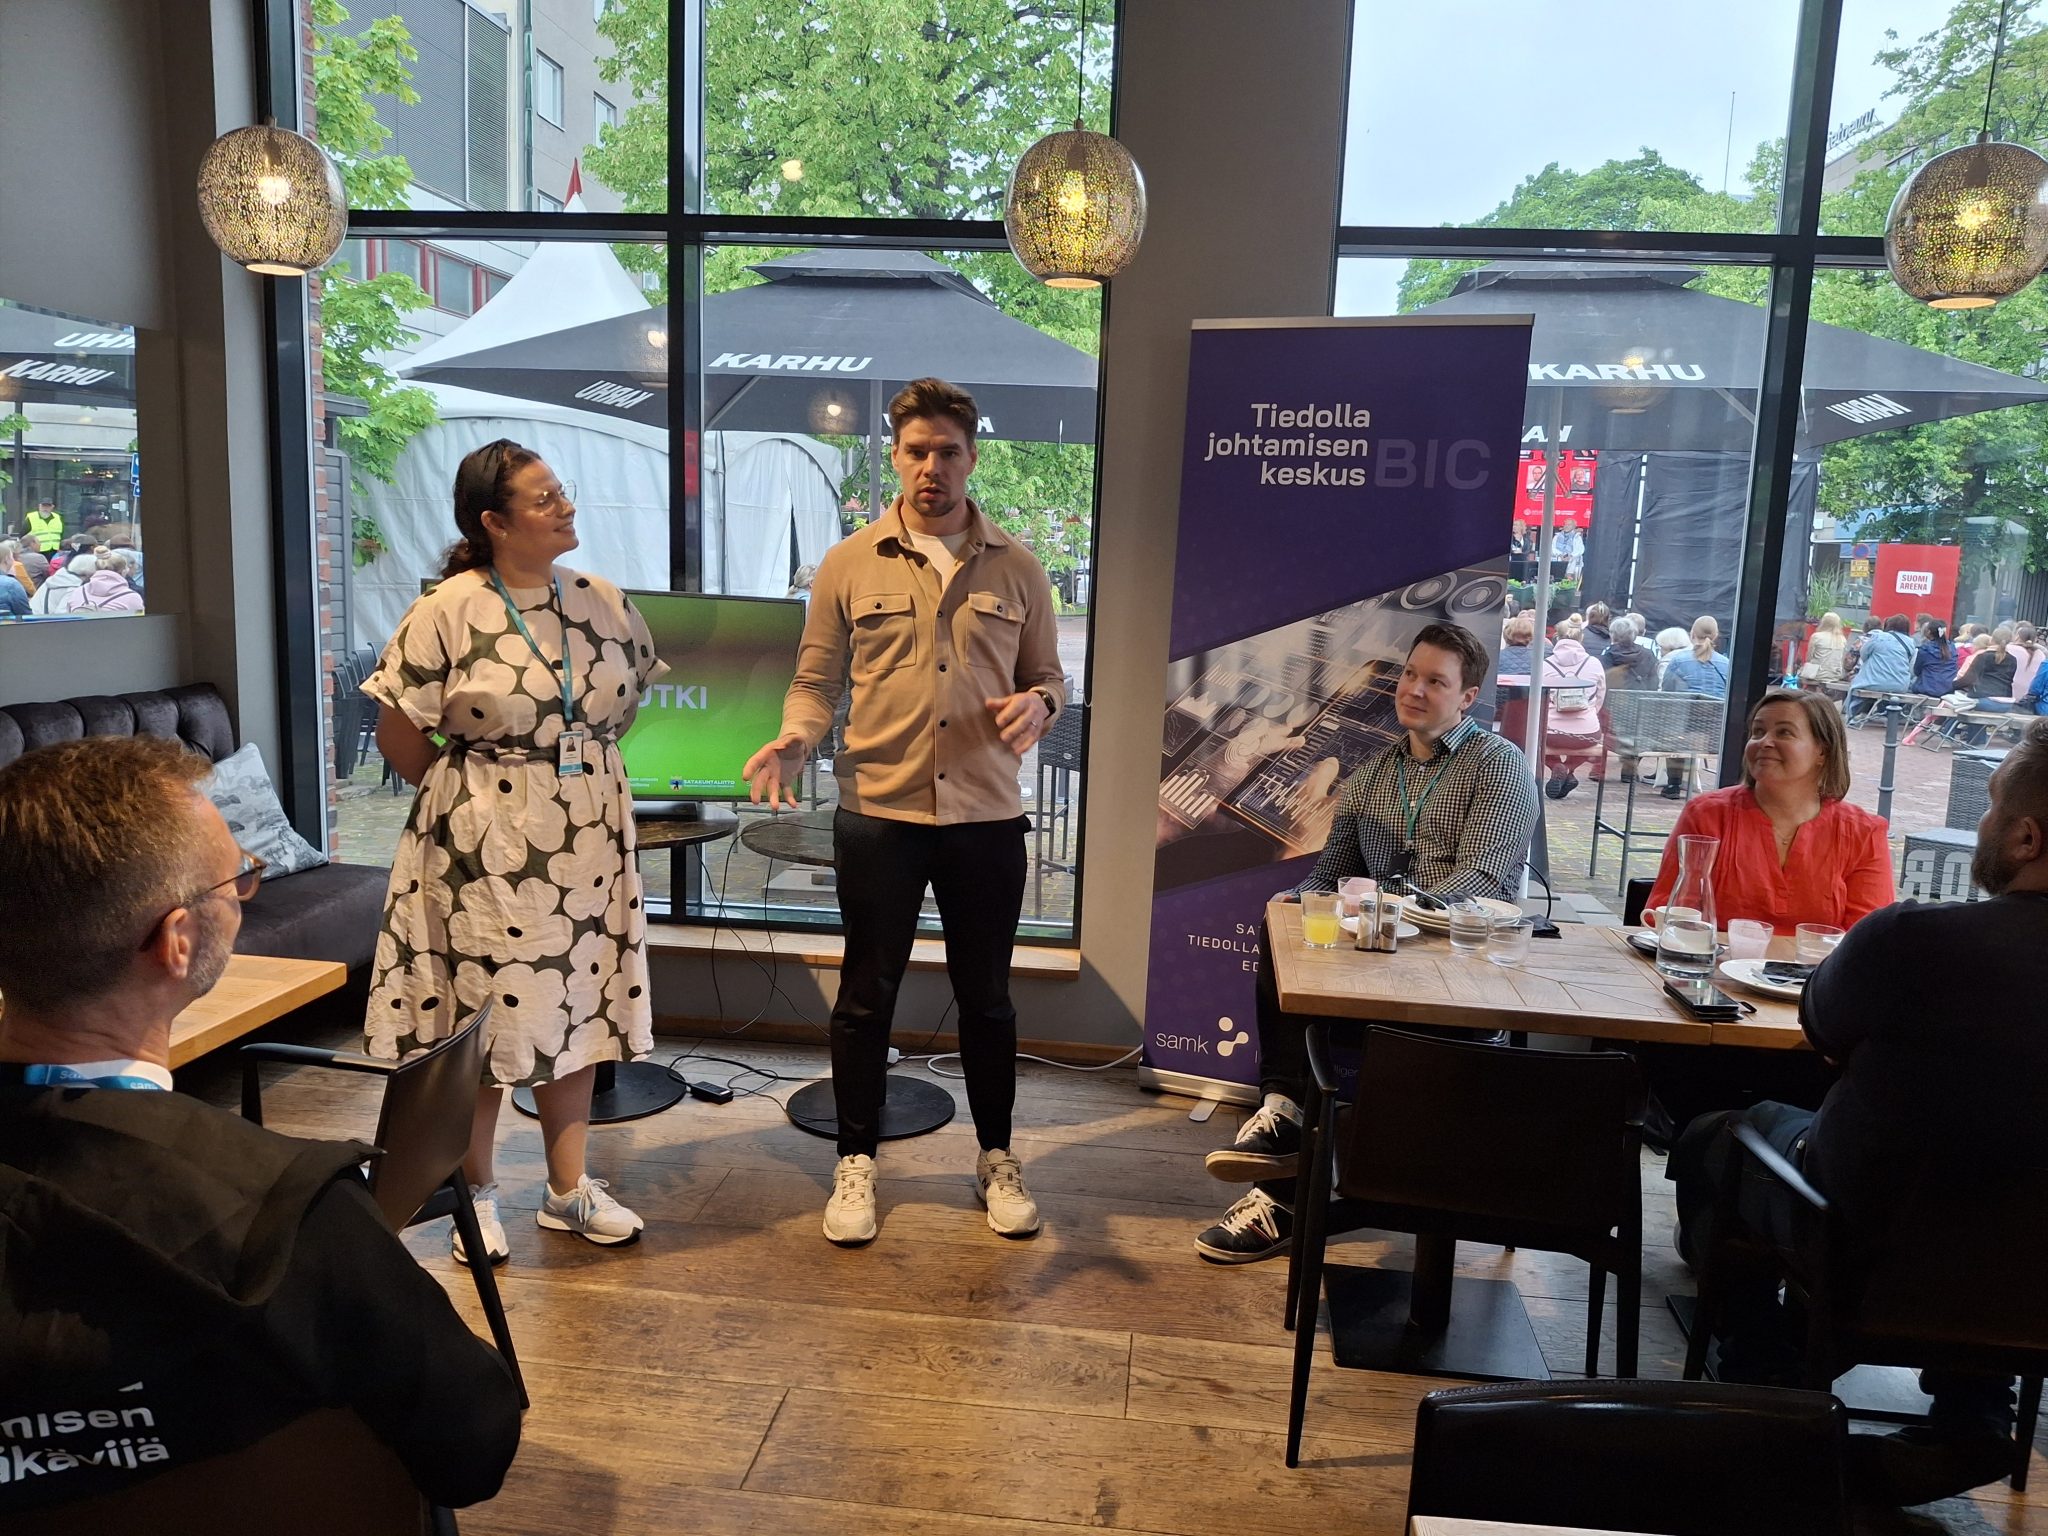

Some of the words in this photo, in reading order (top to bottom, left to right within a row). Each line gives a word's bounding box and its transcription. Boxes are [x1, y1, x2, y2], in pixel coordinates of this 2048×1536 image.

[1828, 108, 1875, 149] ietoevry
[0, 359, 116, 386] KARHU
[708, 352, 873, 372] KARHU
[1528, 363, 1706, 381] KARHU
[1251, 403, 1371, 428] Tiedolla
[1204, 432, 1368, 461] johtamisen
[1260, 461, 1366, 486] keskus
[1374, 438, 1492, 490] BIC
[1899, 582, 1928, 591] AREENA
[1901, 574, 1928, 582] SUOMI
[1187, 934, 1260, 954] TIEDOLLA
[1155, 1032, 1209, 1055] samk
